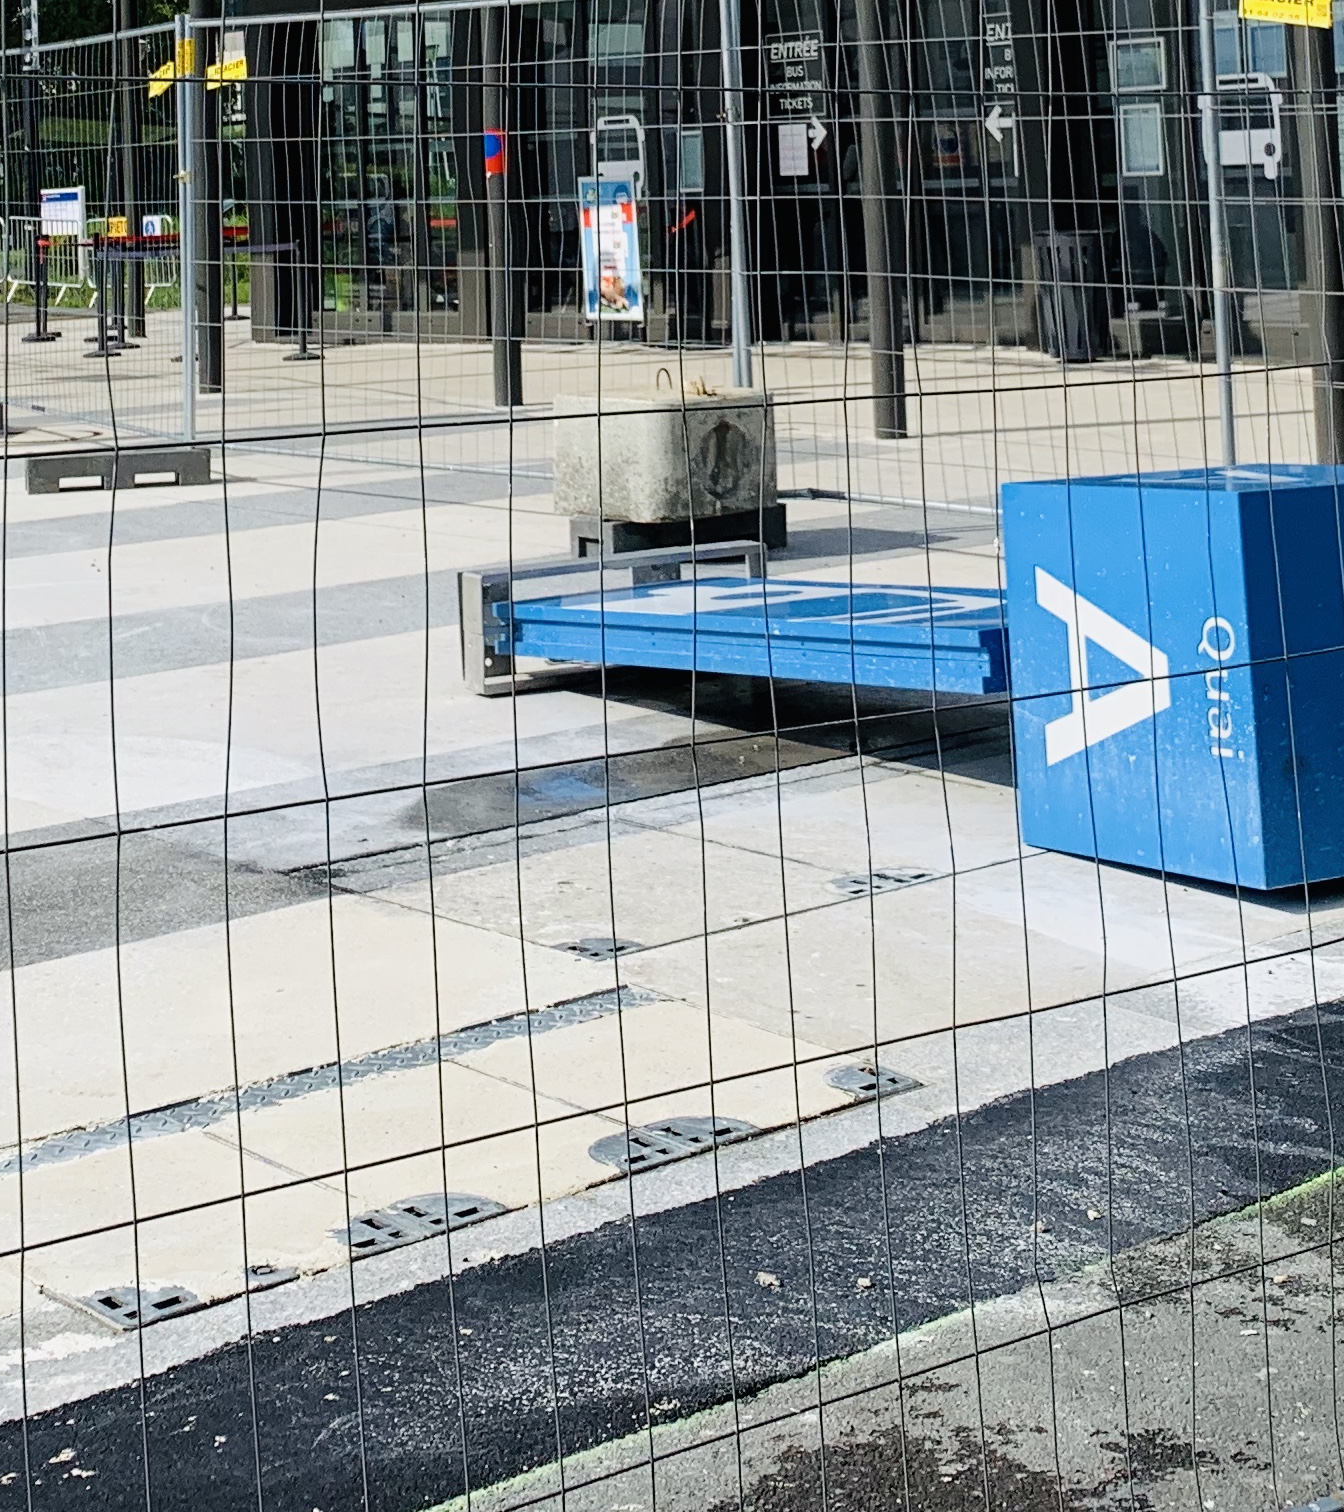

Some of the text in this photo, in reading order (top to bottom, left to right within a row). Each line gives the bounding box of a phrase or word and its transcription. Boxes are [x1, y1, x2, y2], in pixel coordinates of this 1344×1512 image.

[769, 35, 819, 60] ENTRÉE
[786, 65, 805, 78] BUS
[779, 96, 814, 110] TICKETS
[1034, 564, 1172, 767] A
[1197, 616, 1245, 762] Quai
